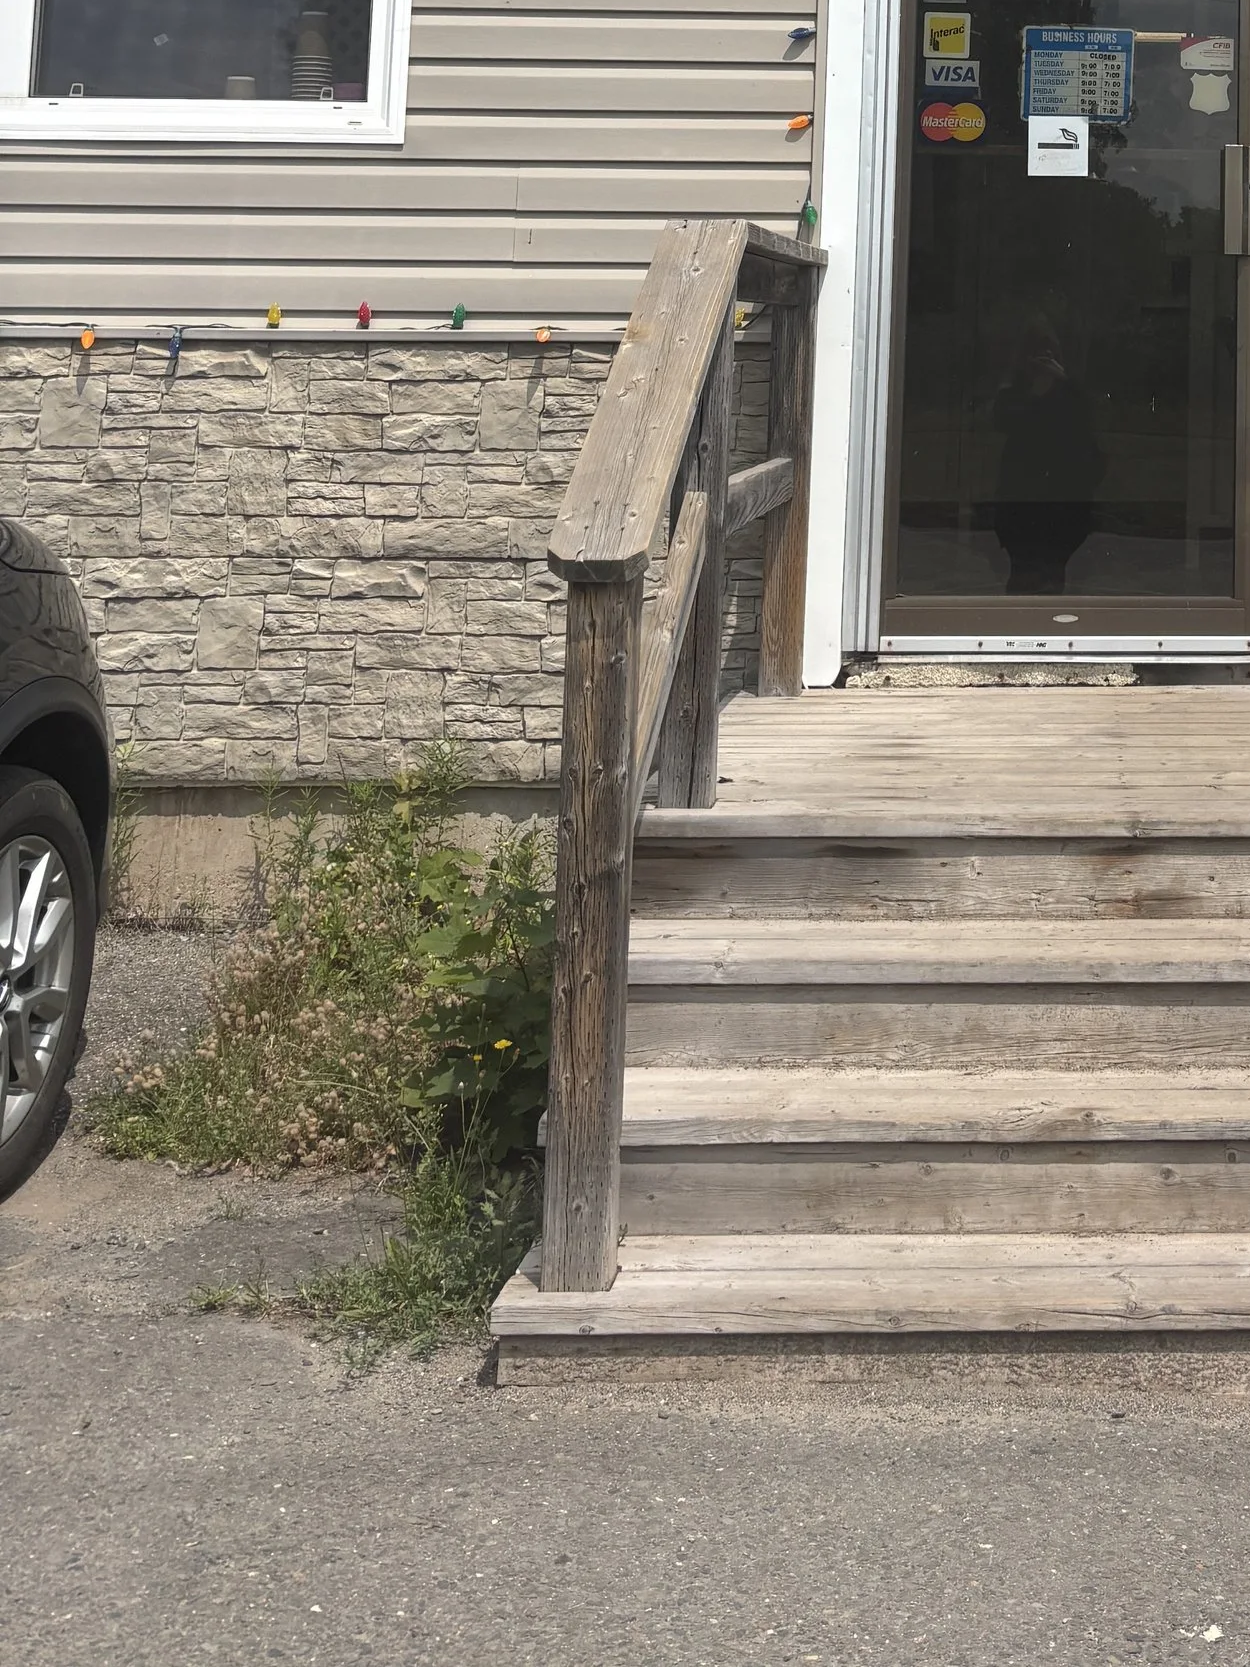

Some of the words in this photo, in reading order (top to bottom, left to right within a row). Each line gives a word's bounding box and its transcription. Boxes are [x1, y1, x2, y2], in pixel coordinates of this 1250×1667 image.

[930, 24, 966, 39] Interac
[1042, 31, 1085, 43] BUSINESS
[1087, 32, 1118, 44] HOURS
[1034, 51, 1064, 59] MONDAY
[1089, 52, 1117, 61] CLOSED
[931, 65, 976, 82] VISA
[922, 115, 984, 128] MasterCard
